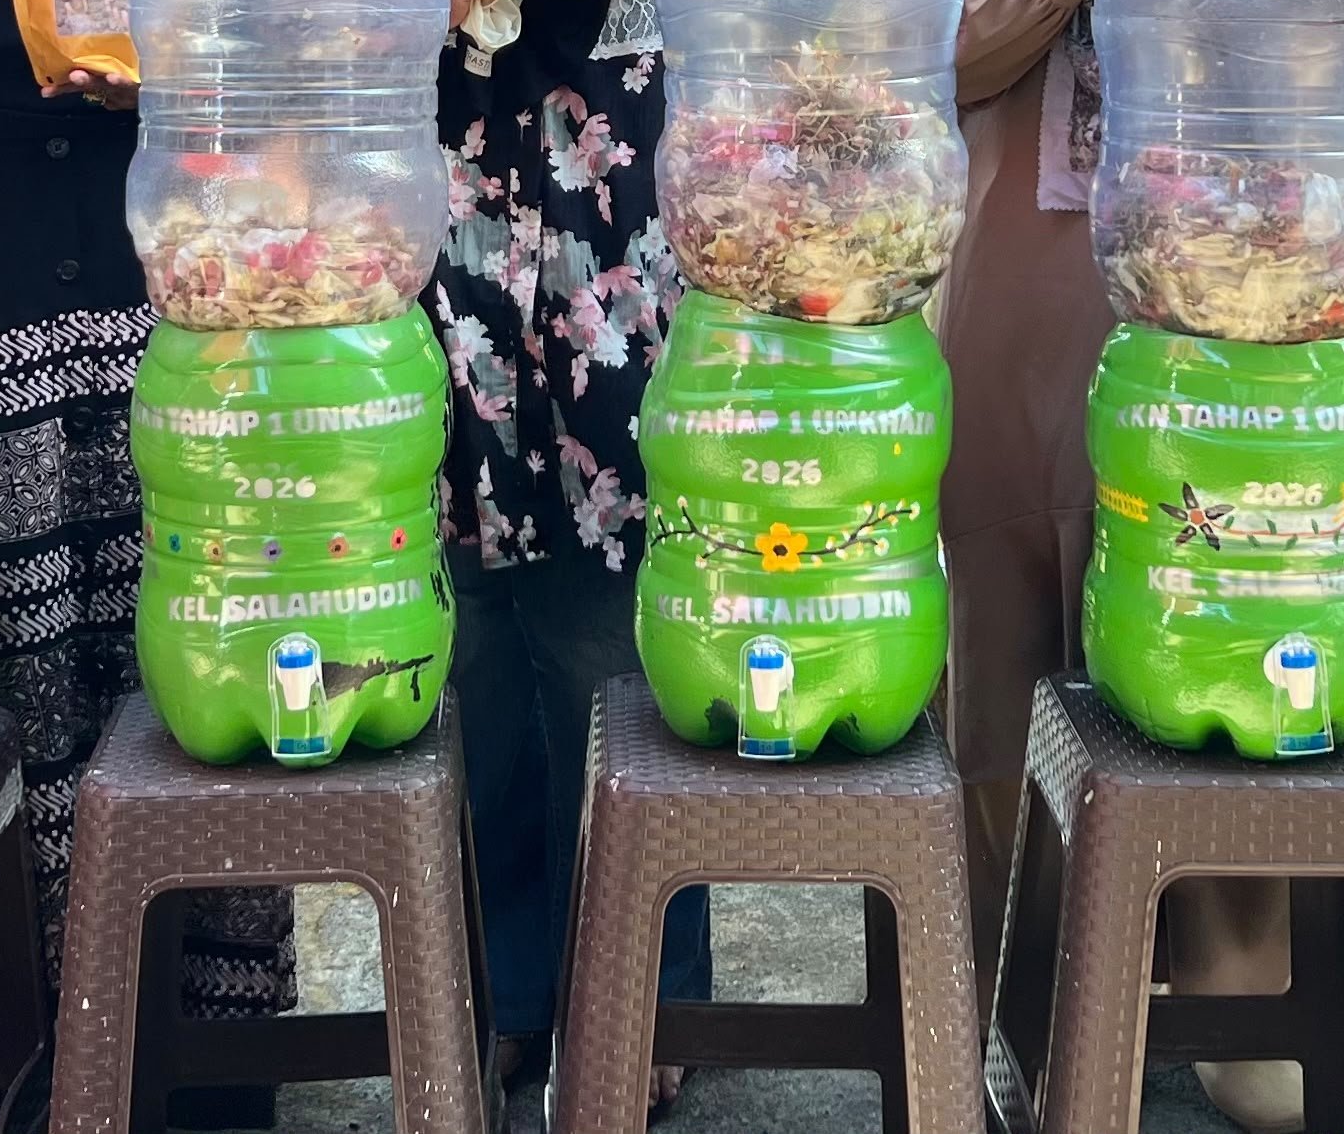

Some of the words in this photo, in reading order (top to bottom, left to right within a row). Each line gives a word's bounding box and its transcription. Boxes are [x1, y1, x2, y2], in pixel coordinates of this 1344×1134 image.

[167, 406, 260, 437] TAHAP
[267, 411, 286, 436] 1
[684, 410, 779, 435] TAHAP
[788, 410, 805, 435] 1
[1176, 404, 1284, 430] TAHAP
[1290, 406, 1310, 432] 1
[741, 457, 823, 487] 2026
[233, 474, 317, 499] 2026
[1241, 480, 1324, 507] 2026
[1148, 565, 1208, 596] KEL.
[169, 595, 219, 623] KEL.
